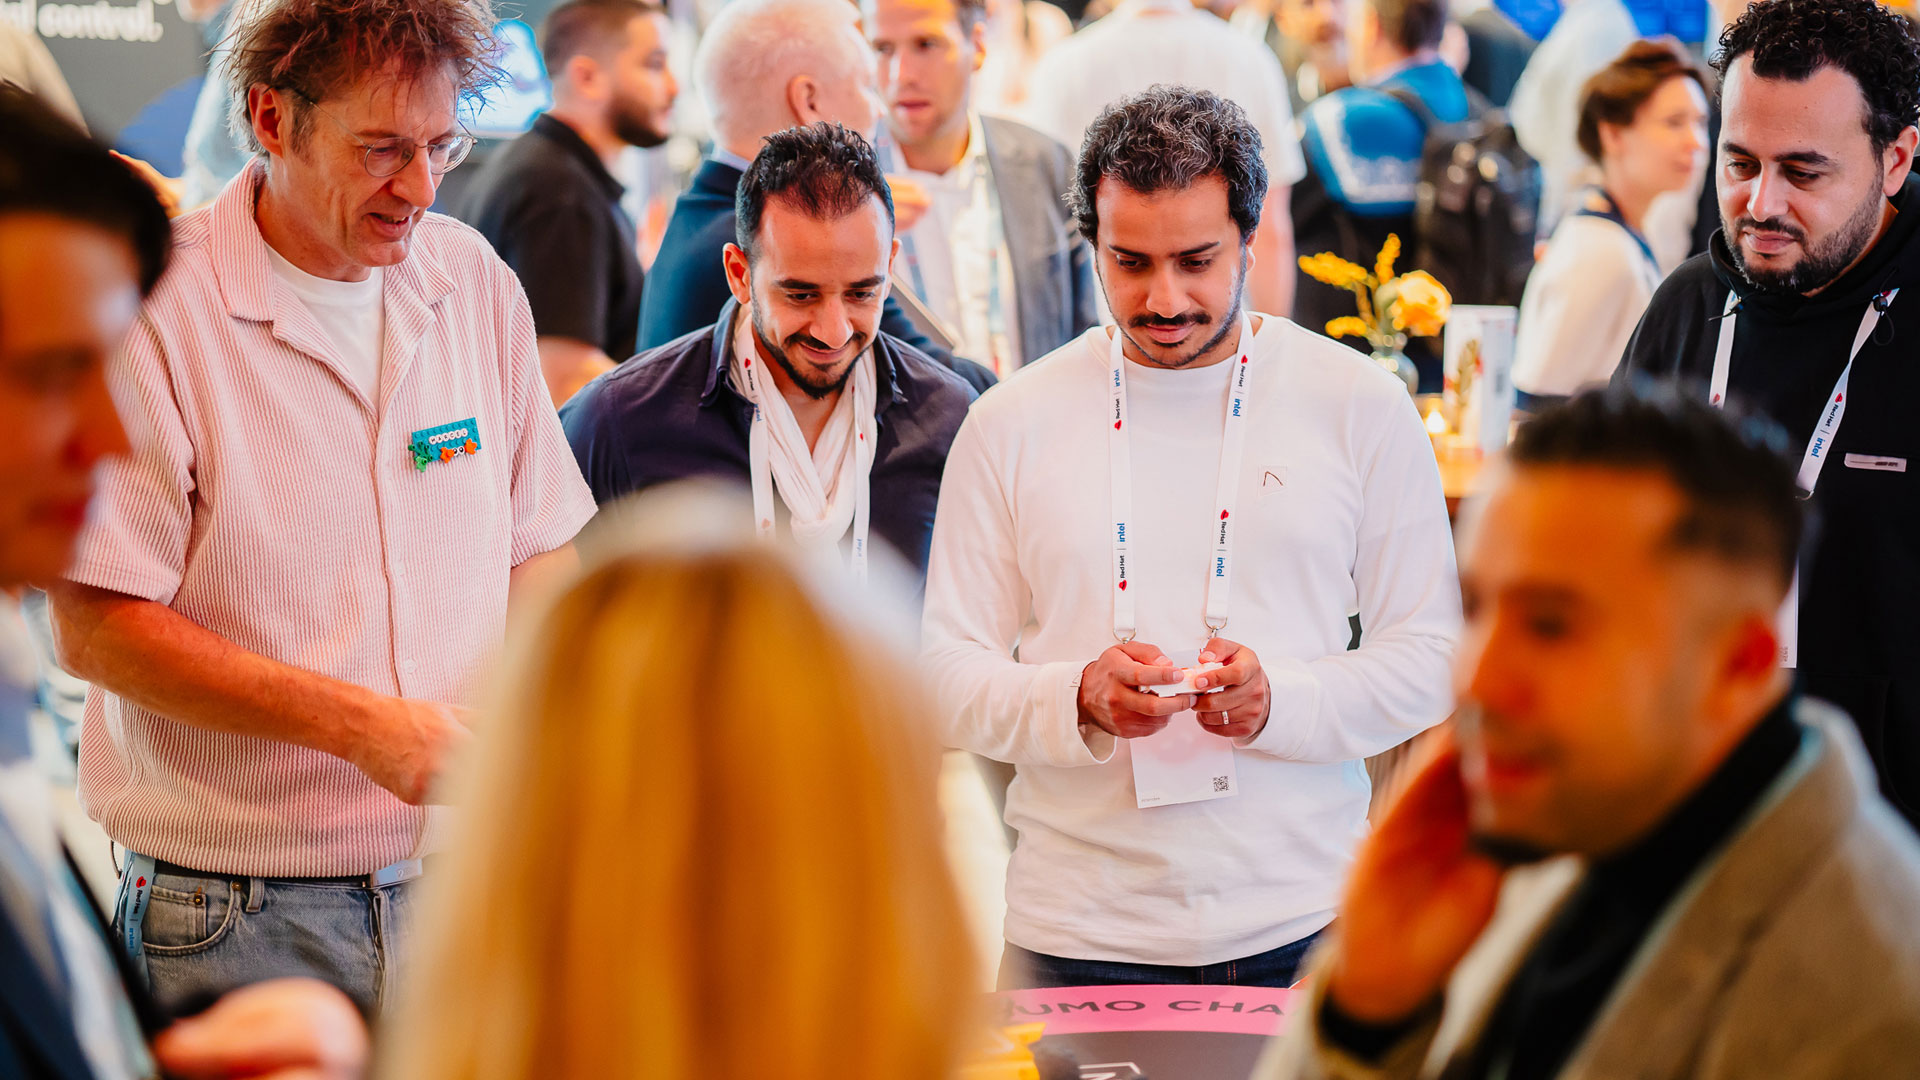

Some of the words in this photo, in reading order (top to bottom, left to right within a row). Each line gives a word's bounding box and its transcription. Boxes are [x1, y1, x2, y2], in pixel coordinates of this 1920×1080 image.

[38, 0, 164, 42] control.
[1113, 369, 1121, 387] intel
[1232, 398, 1243, 417] intel
[1831, 404, 1839, 417] Red
[1825, 415, 1833, 427] Hat
[429, 429, 467, 443] MARCEL
[1811, 437, 1825, 458] intel
[1116, 522, 1126, 543] intel
[1216, 557, 1226, 577] intel
[128, 927, 136, 949] intel
[1014, 1000, 1146, 1016] UMO
[1167, 1000, 1285, 1016] CHA
